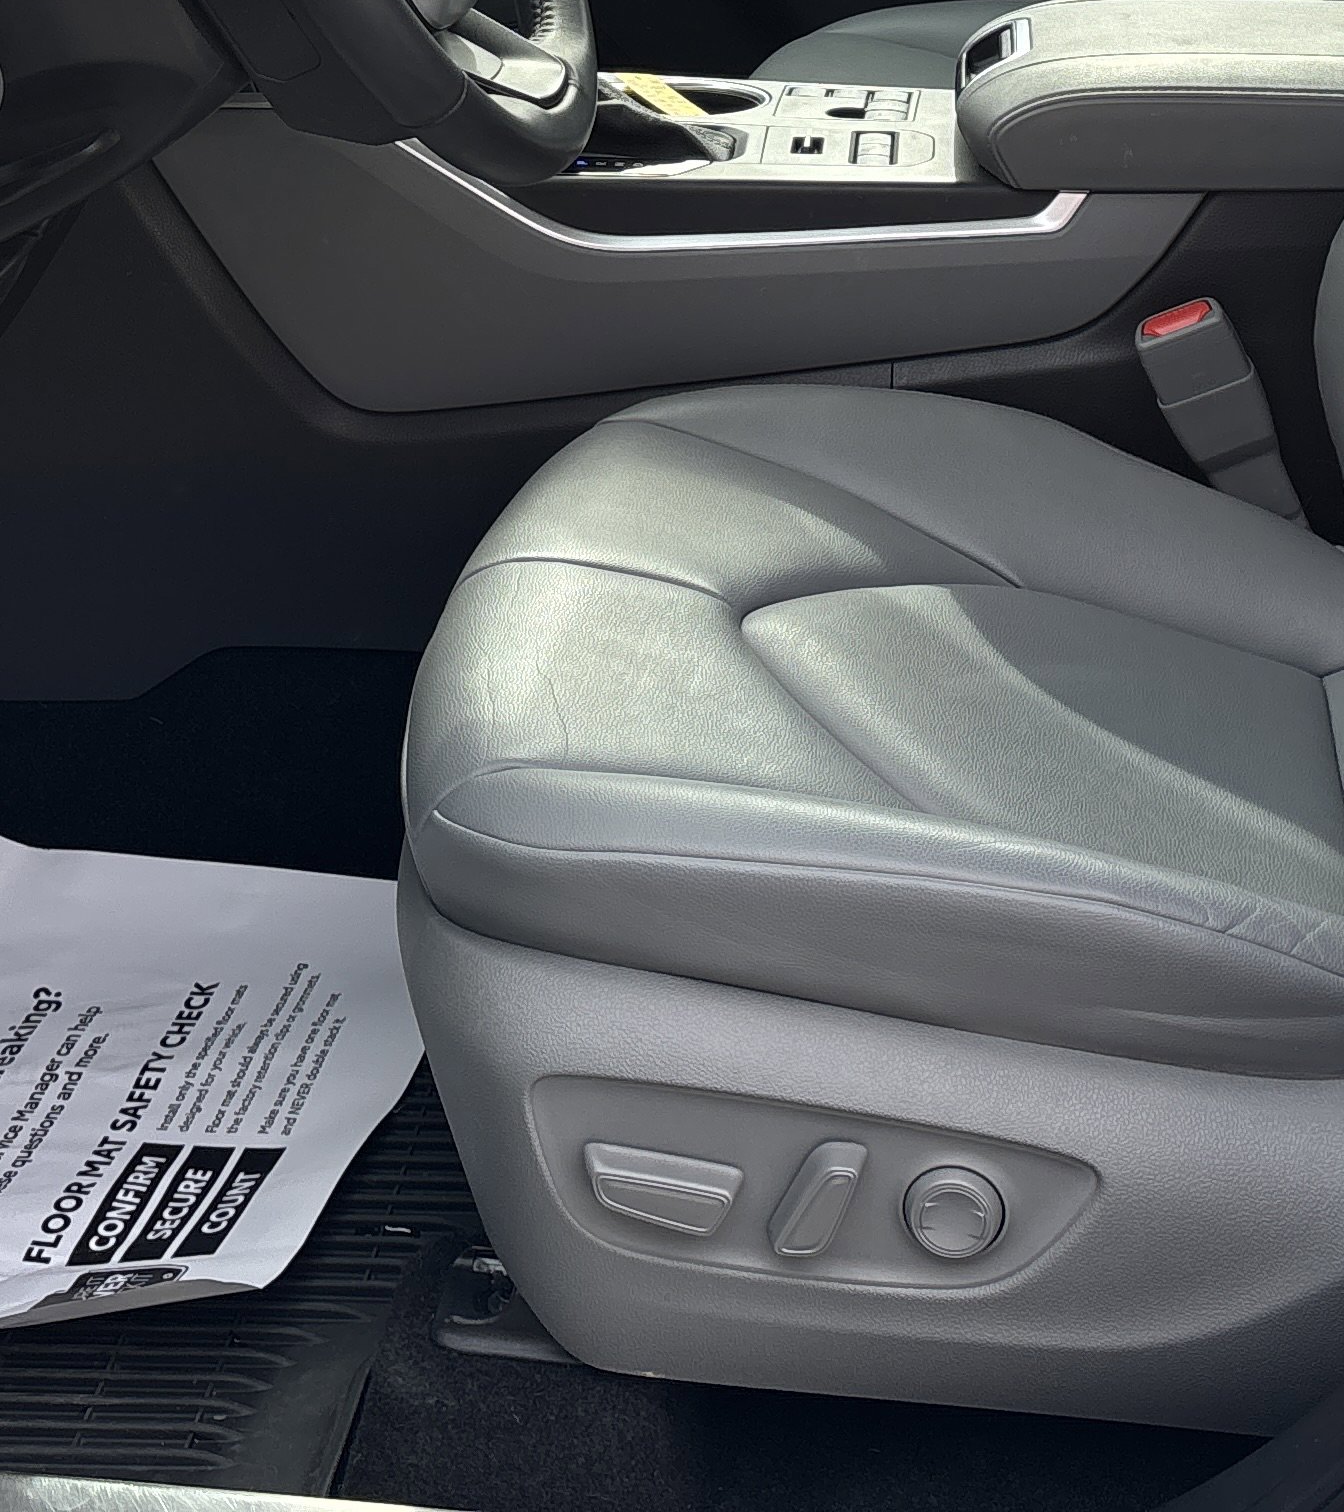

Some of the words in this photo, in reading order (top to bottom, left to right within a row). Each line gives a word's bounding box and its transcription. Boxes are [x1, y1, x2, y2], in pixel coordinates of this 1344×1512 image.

[56, 1034, 82, 1057] can
[68, 1006, 102, 1033] help
[11, 1104, 64, 1169] questions
[57, 1071, 83, 1101] and
[76, 1033, 110, 1068] more.
[12, 1058, 63, 1129] Manager
[23, 1181, 97, 1264] FLOOR
[77, 1136, 126, 1181] MAT
[110, 1051, 174, 1133] SAFETY
[160, 981, 221, 1049] CHECK
[89, 1155, 167, 1252] CONFIRM
[146, 1168, 213, 1241] SECURE
[201, 1171, 261, 1234] COUNT
